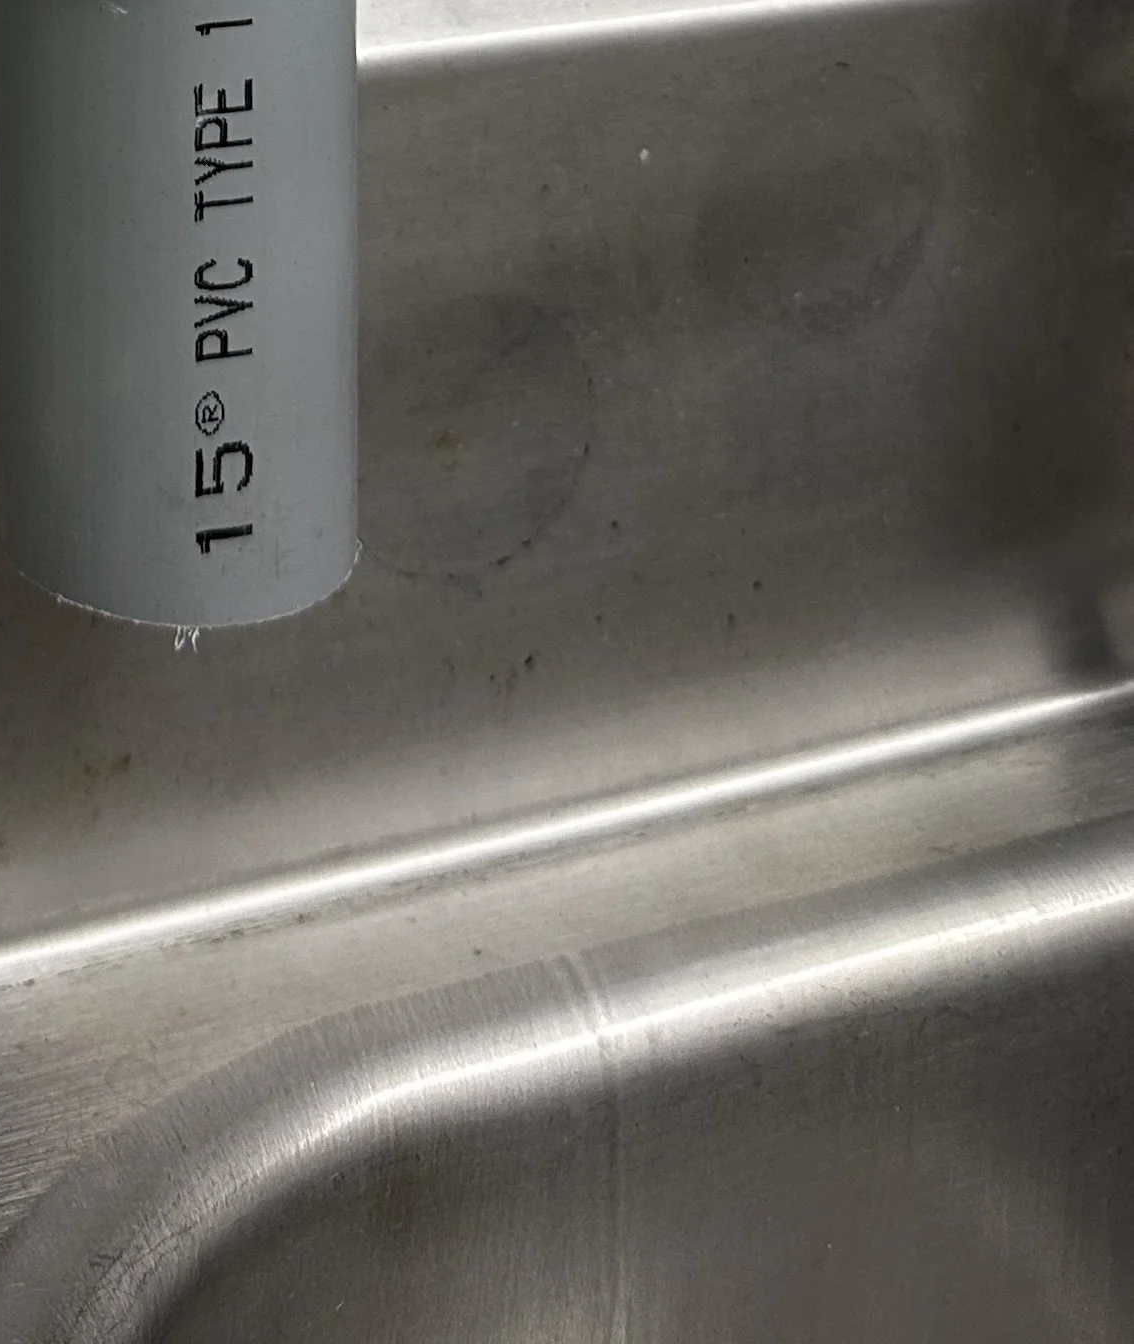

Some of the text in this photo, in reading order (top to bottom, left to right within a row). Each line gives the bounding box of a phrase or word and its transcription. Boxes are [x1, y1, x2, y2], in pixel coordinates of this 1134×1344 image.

[194, 18, 254, 37] 1
[193, 78, 254, 223] TYPE
[193, 258, 254, 363] PVC
